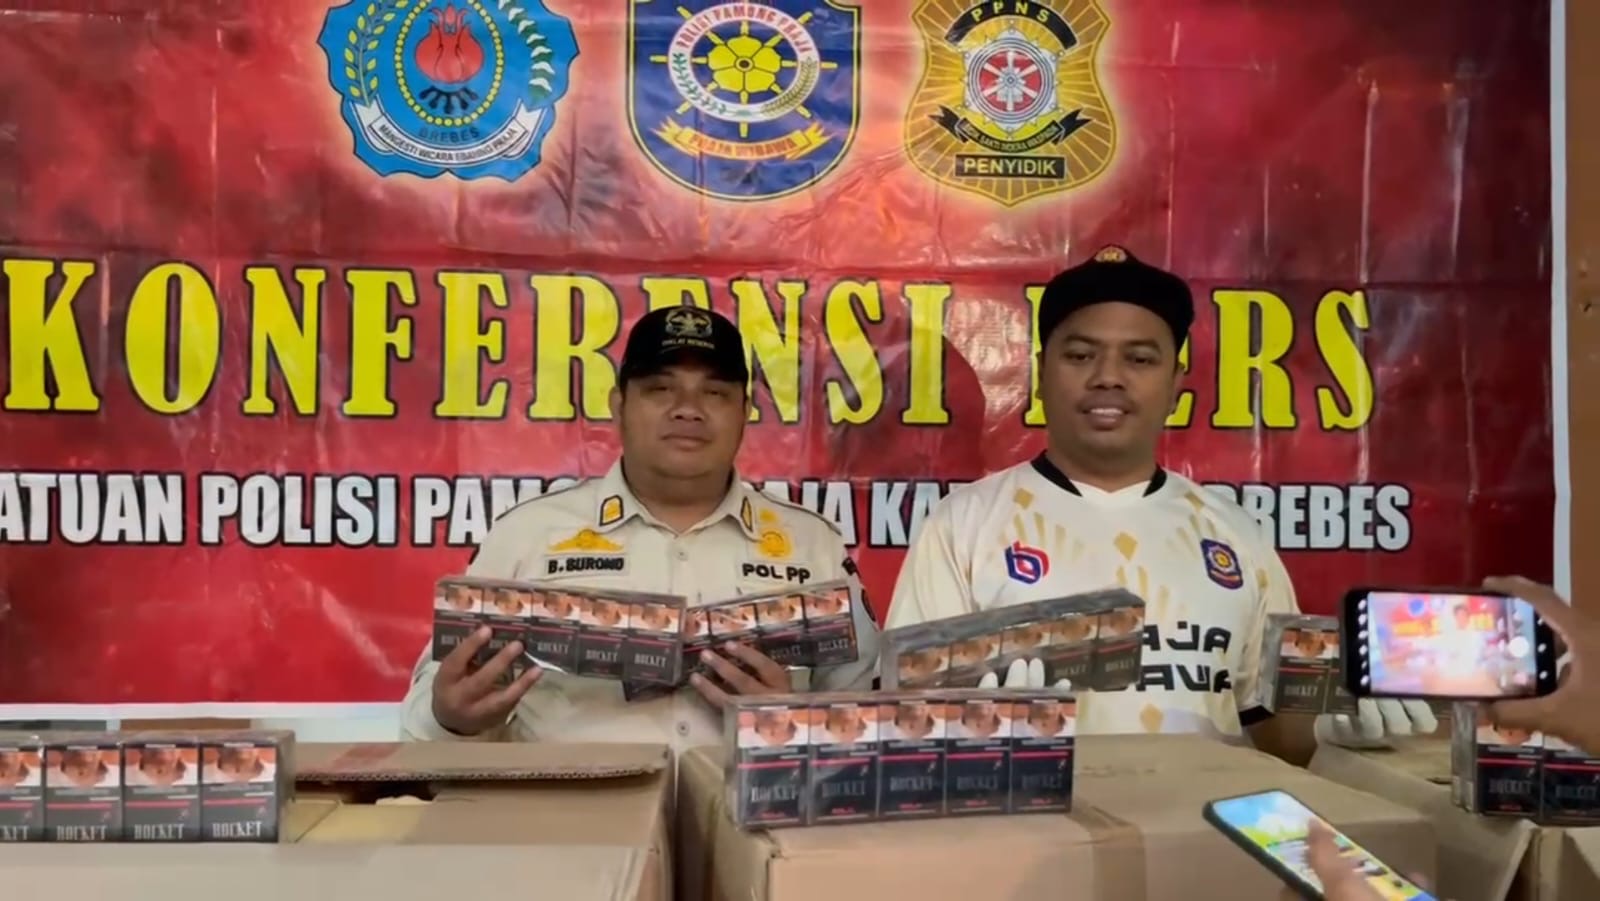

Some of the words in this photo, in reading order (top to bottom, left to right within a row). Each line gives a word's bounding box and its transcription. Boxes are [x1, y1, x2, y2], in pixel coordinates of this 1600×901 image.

[971, 2, 1049, 23] PPNS
[676, 14, 712, 48] POLISI
[712, 5, 777, 22] PAMONG
[419, 127, 480, 142] BREBES
[963, 157, 1057, 176] PENYIDIK
[3, 259, 952, 425] KONFERNSI
[1024, 286, 1375, 430] RS
[201, 475, 396, 545] POLISI
[414, 477, 577, 545] PA
[742, 563, 783, 580] POL
[786, 566, 811, 584] PP
[0, 825, 29, 841] KET
